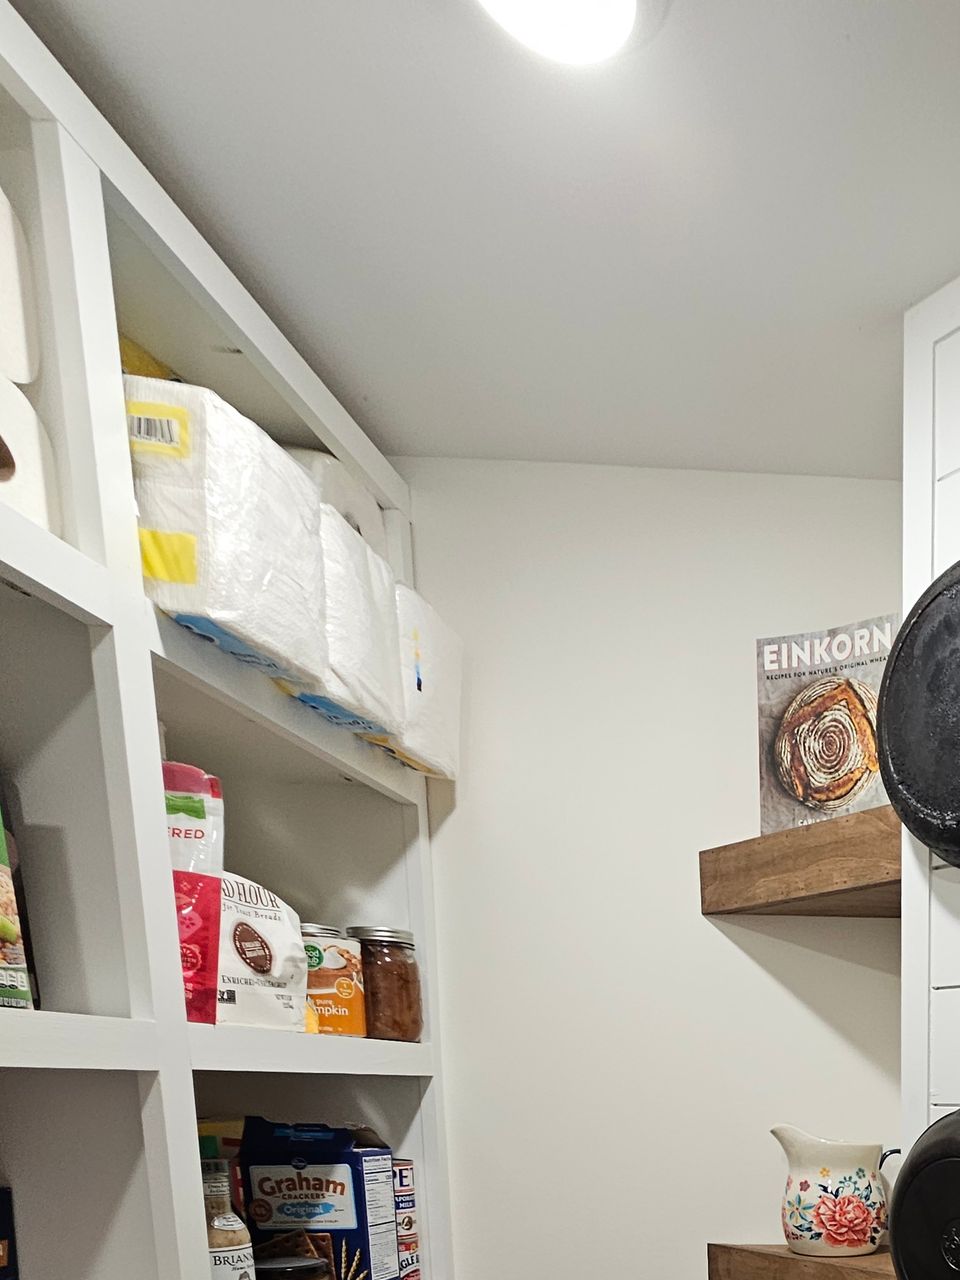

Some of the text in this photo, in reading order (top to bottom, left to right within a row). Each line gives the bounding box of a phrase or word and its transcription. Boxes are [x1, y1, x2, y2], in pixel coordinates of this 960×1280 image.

[763, 622, 893, 671] EINKORN
[766, 672, 792, 681] RECIPES
[808, 666, 838, 676] NATURE'S
[839, 660, 868, 671] ORIGINAL
[168, 826, 205, 839] RED
[234, 881, 280, 909] FLOUR
[258, 1171, 346, 1196] Graham
[281, 1192, 326, 1200] CRACKERS
[283, 1204, 323, 1215] Original
